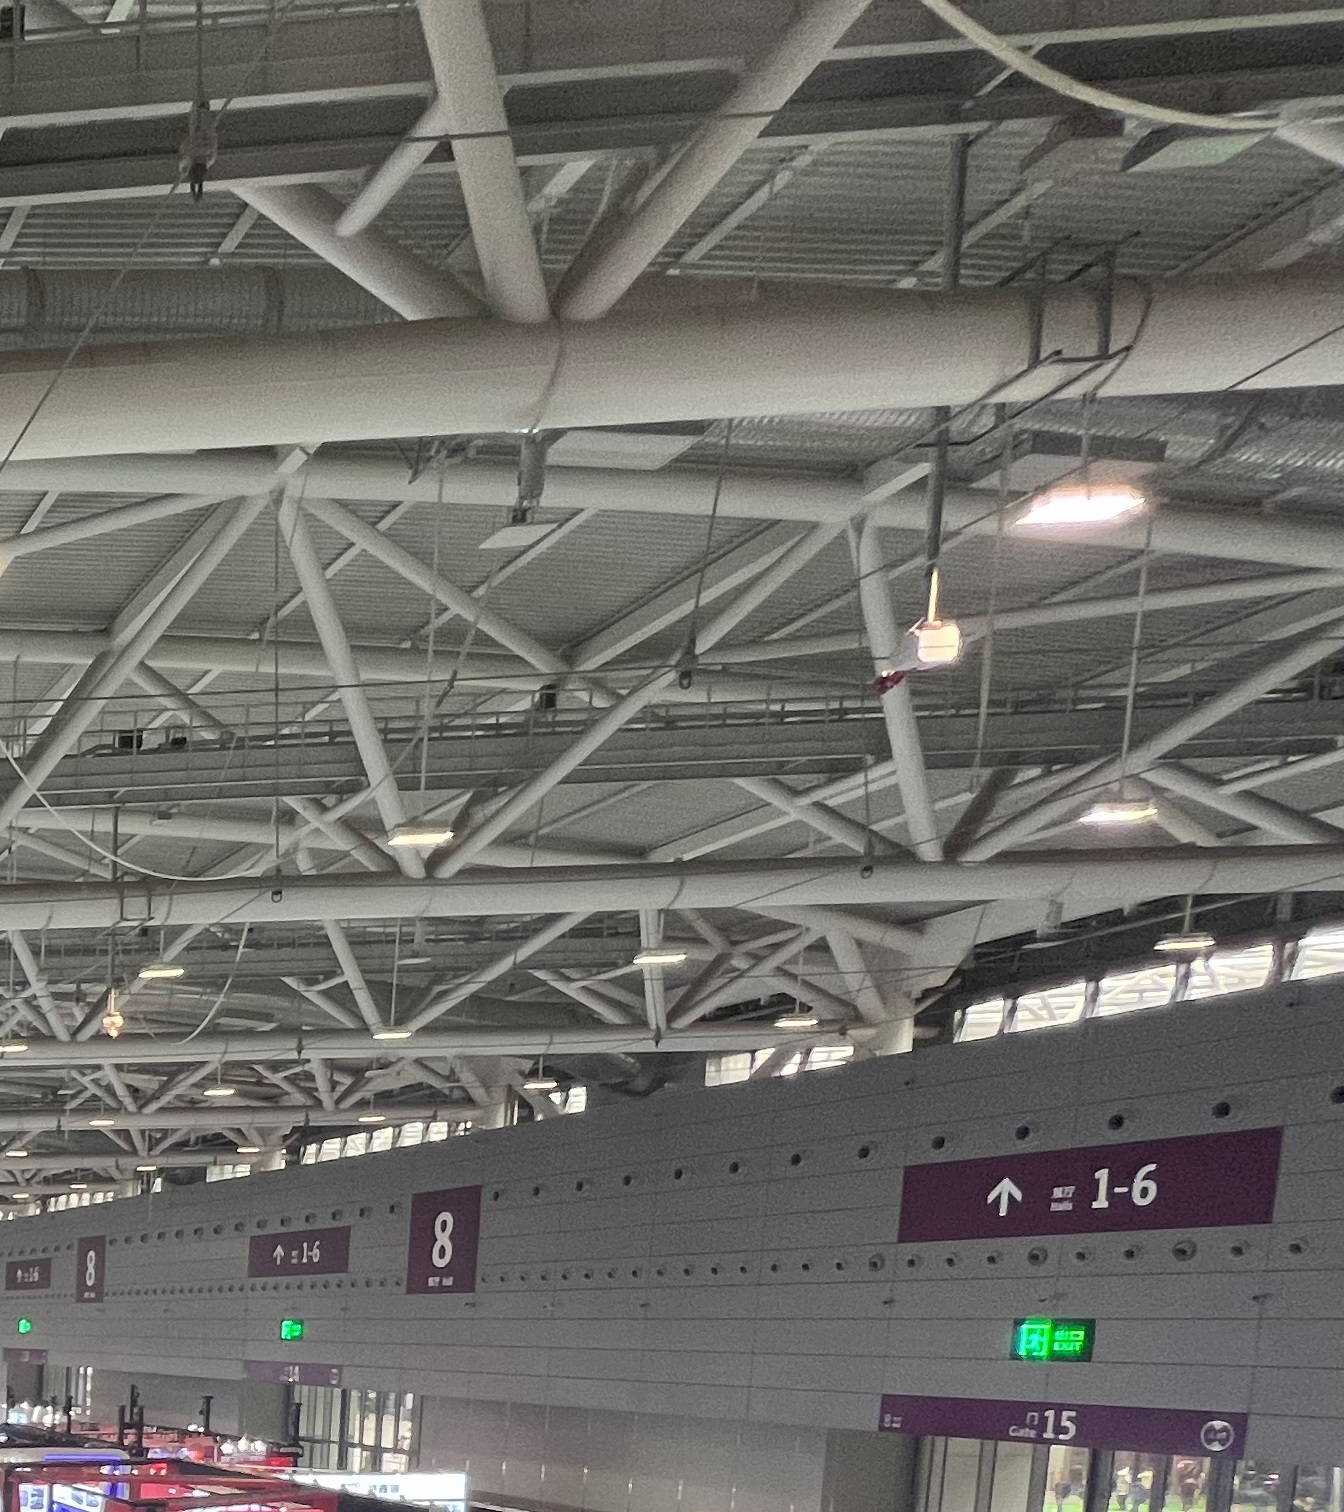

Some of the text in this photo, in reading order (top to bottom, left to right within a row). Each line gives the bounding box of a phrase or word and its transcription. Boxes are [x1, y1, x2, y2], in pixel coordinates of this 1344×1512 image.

[1091, 1163, 1158, 1210] 1-6
[431, 1211, 454, 1268] 8
[84, 1249, 96, 1287] 8
[1042, 1409, 1078, 1440] 15
